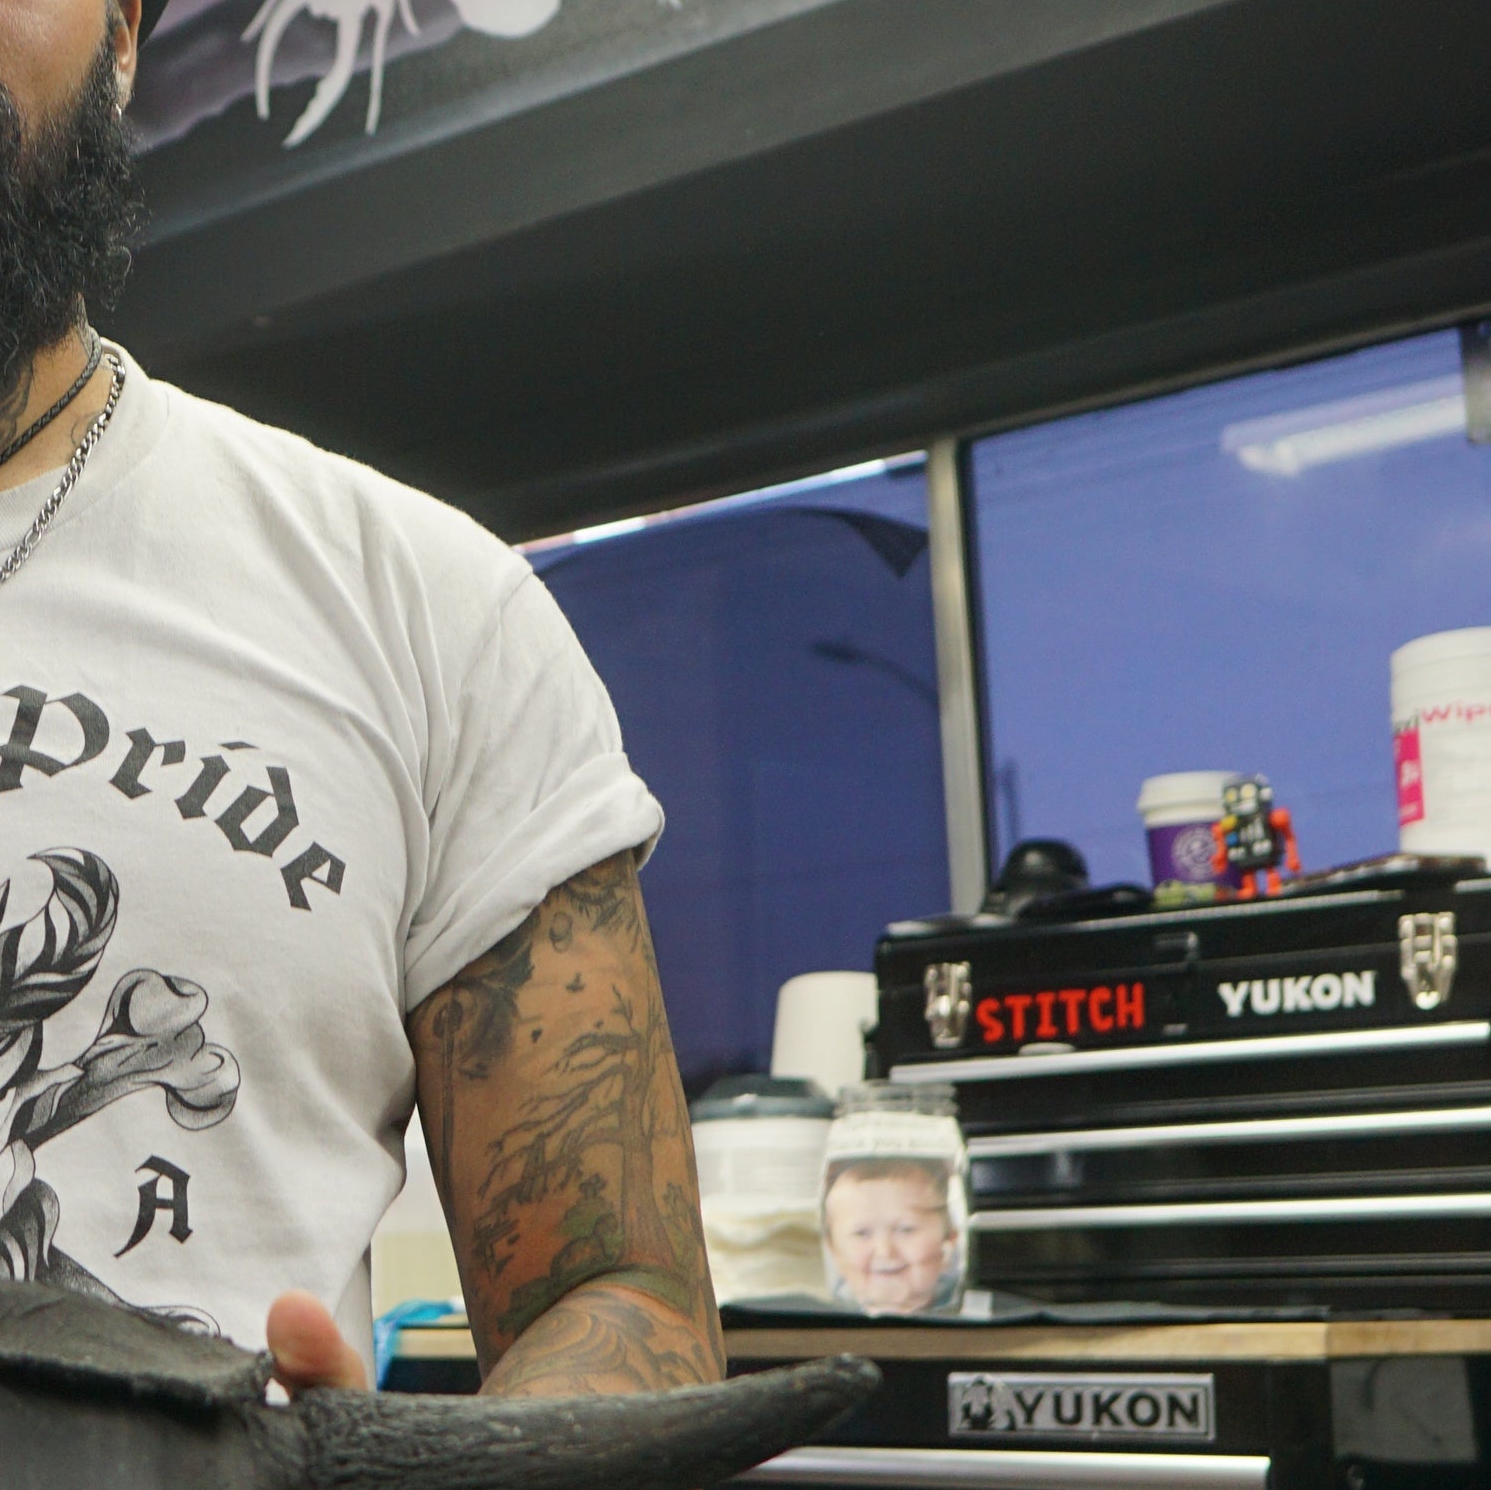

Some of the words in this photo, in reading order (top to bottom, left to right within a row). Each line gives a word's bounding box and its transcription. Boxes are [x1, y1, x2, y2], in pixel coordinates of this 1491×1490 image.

[976, 982, 1145, 1043] STITCH
[1219, 970, 1377, 1018] YUKON
[113, 1154, 194, 1259] A
[1014, 1390, 1200, 1428] YUKON
